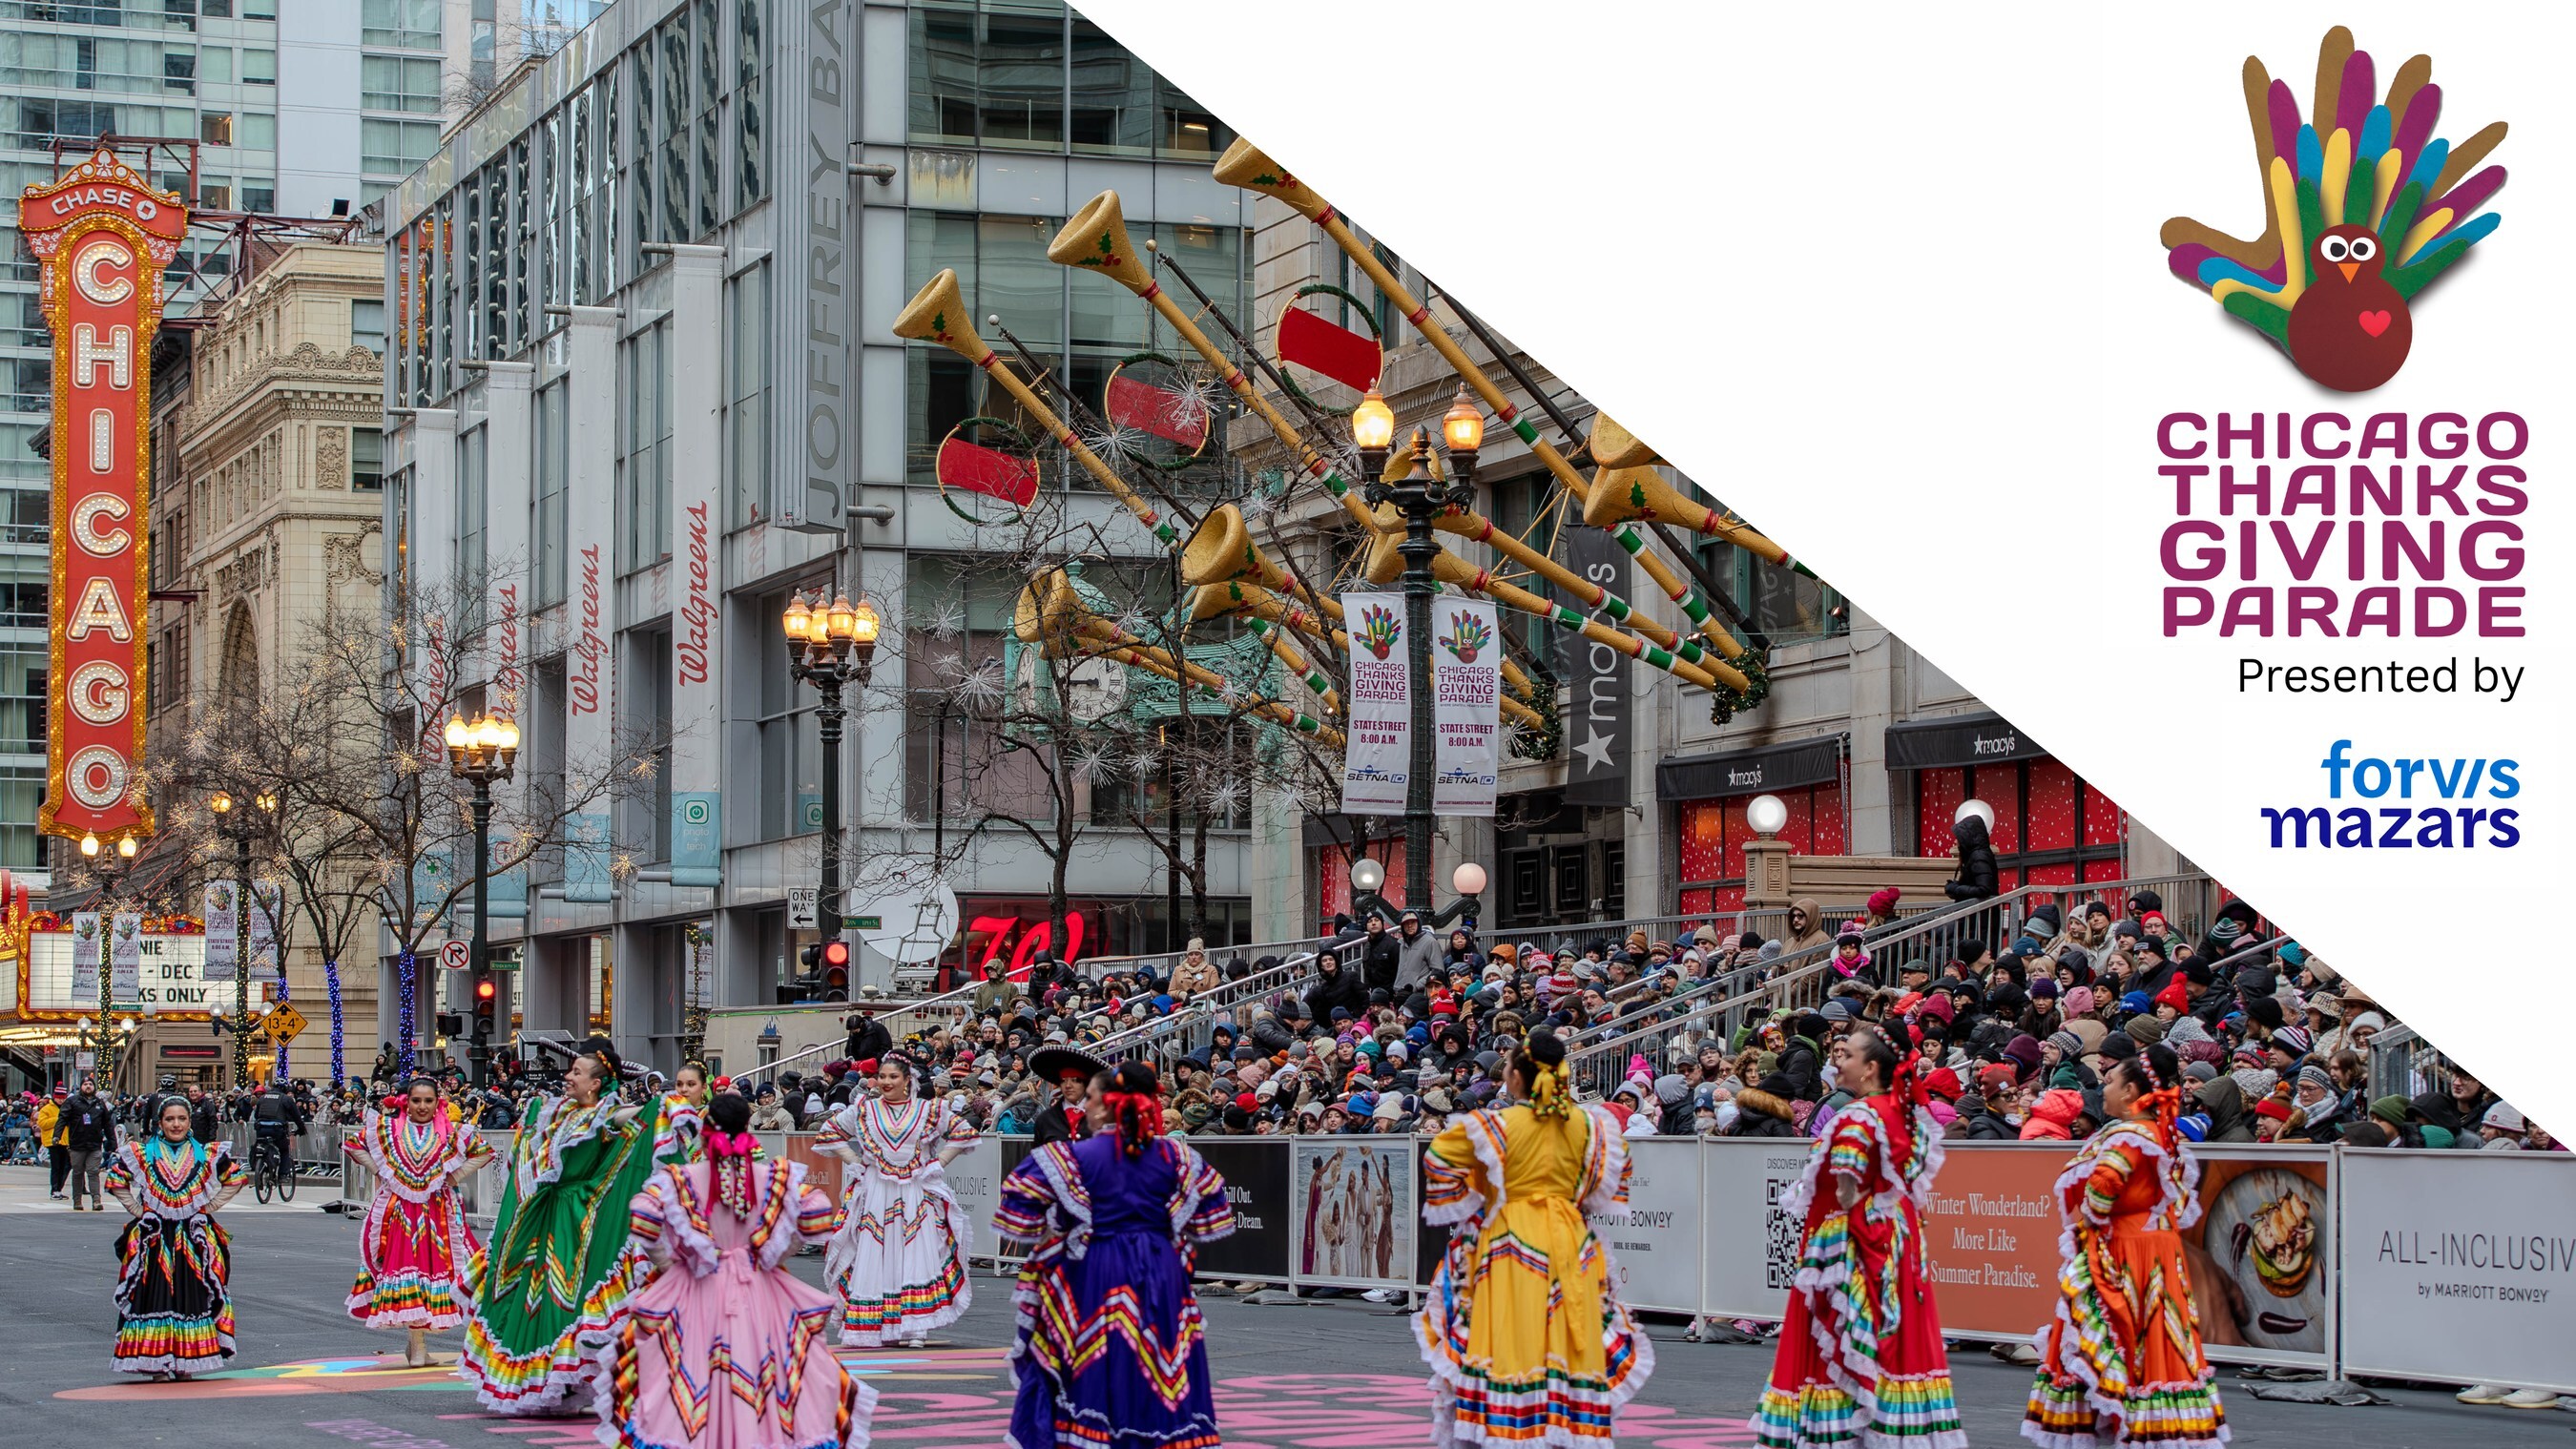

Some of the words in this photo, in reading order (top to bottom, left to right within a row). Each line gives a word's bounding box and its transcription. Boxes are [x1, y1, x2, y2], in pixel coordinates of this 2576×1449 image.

[51, 188, 135, 216] CHASE
[809, 134, 841, 519] JOFFREY
[66, 240, 134, 810] CHICAGO
[676, 500, 717, 687] Walgreens
[570, 543, 609, 716] Walgreens
[1355, 661, 1405, 672] CHICAGO
[1438, 666, 1494, 675] CHICAGO
[1355, 670, 1406, 681] THANKS
[1438, 674, 1494, 684] THANKS
[1355, 679, 1406, 691] GIVING
[1439, 683, 1494, 694] GIVING
[1355, 690, 1406, 701] PARADE
[1440, 694, 1494, 704] PARADE
[1353, 720, 1377, 730] STATE
[1378, 721, 1407, 732] STREET
[1440, 724, 1464, 733] STATE
[1465, 724, 1494, 735] STREET
[1361, 734, 1380, 744] 8:00
[1381, 734, 1398, 745] A.M.
[1448, 737, 1467, 746] 8:00
[1469, 737, 1485, 747] A.M.
[1347, 773, 1389, 783] SETNA
[1437, 776, 1478, 784] SETNA
[684, 828, 709, 837] photo
[687, 841, 706, 850] tech
[792, 891, 814, 901] ONE
[162, 964, 193, 979] DEC
[167, 988, 208, 1003] ONLY
[268, 1018, 299, 1029] 13'-4"
[1766, 1158, 1797, 1170] DISCOVER
[1236, 1186, 1252, 1203] Out.
[1925, 1192, 1966, 1215] Winter
[1968, 1193, 2051, 1218] Wonderland?
[1237, 1211, 1263, 1229] Dream.
[1631, 1210, 1672, 1228] BONVOY
[1953, 1227, 1984, 1250] More
[1987, 1228, 2016, 1252] Like
[2379, 1231, 2576, 1272] ALL-INCLUSIV
[1931, 1260, 1981, 1284] Summer
[1984, 1263, 2039, 1288] Paradise.
[2418, 1282, 2431, 1299] by
[2435, 1283, 2494, 1299] MARRIOTT
[2499, 1287, 2548, 1303] BONVOY
